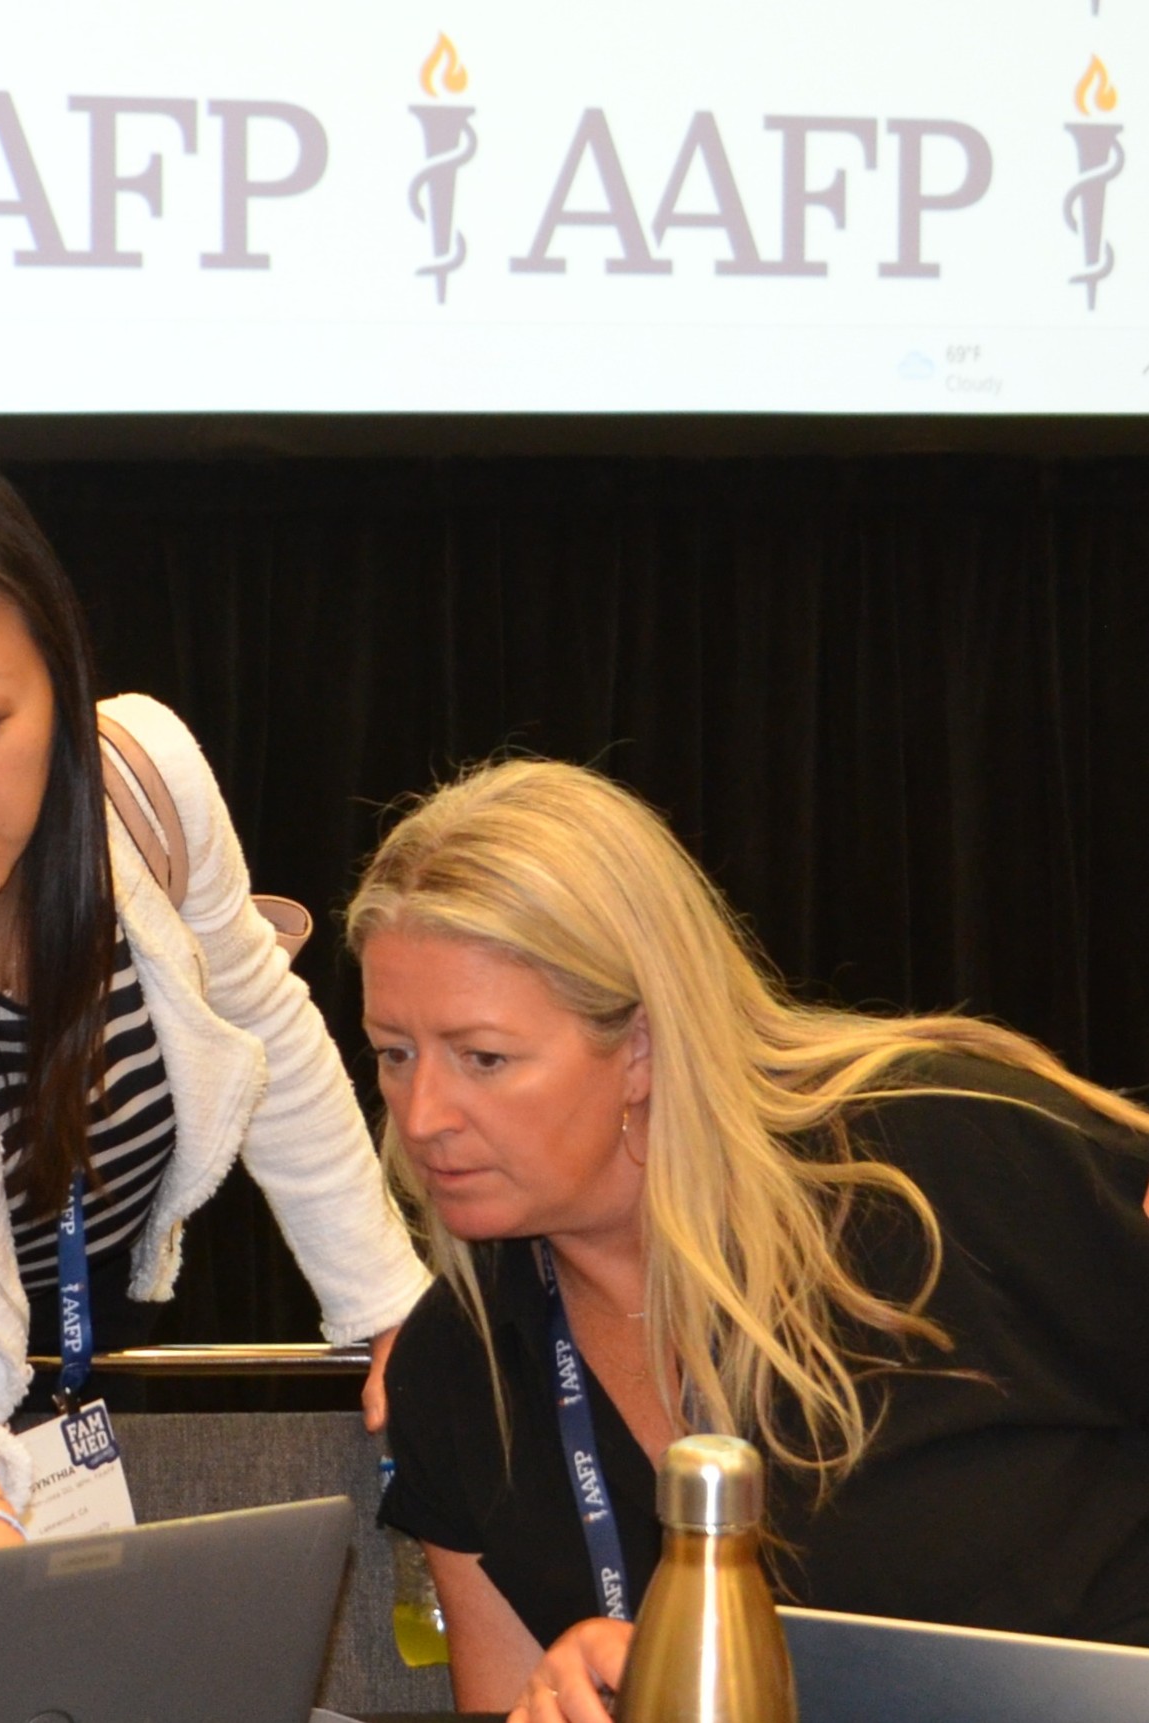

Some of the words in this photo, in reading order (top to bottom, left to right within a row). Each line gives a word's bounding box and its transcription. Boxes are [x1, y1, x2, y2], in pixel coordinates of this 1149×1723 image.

[508, 107, 994, 279] AAFP
[944, 374, 1005, 397] Cloudy
[62, 1296, 83, 1353] AAFP
[555, 1339, 581, 1391] AAFP
[65, 1411, 106, 1443] FAM
[71, 1430, 110, 1462] MED
[574, 1450, 605, 1506] AAFP
